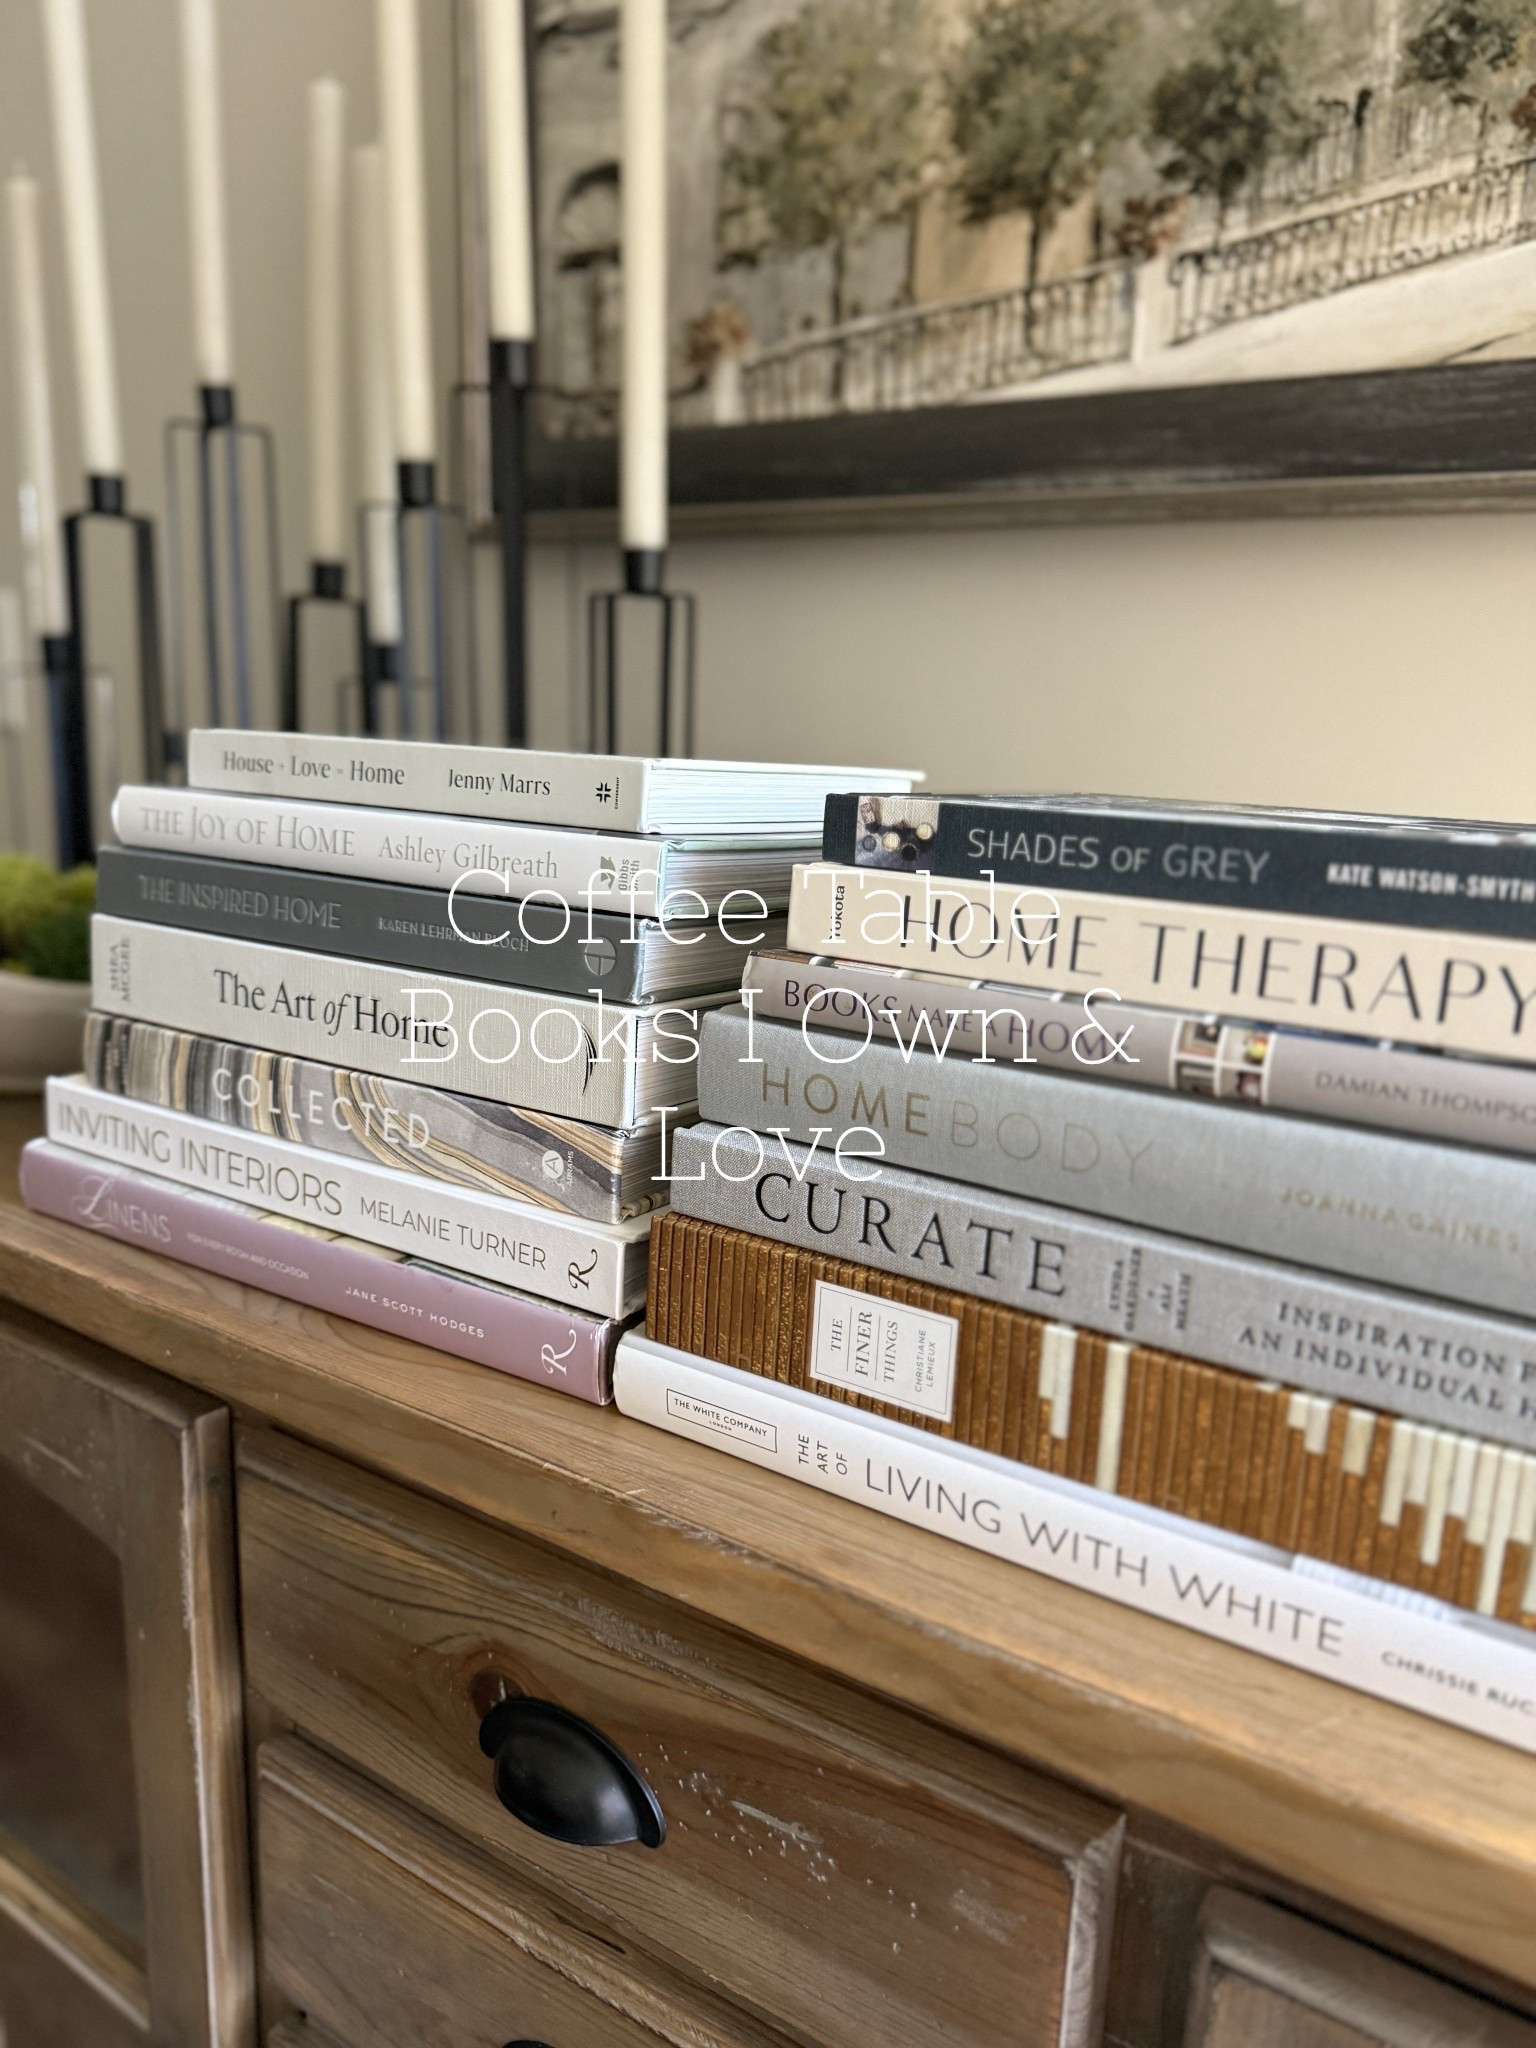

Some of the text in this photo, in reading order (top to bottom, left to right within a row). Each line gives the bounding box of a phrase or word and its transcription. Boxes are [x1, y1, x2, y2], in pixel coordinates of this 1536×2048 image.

[223, 750, 274, 774] House
[291, 755, 331, 778] Love
[350, 760, 405, 785] Home
[448, 769, 551, 796] Jenny Marrs
[140, 806, 355, 857] THE JOY OF HOME
[378, 834, 558, 879] Ashley Gilbreath
[968, 828, 1271, 885] SHADES OF GREY
[138, 874, 342, 929] THE INSPIRED HOME
[618, 859, 629, 891] Gibbs
[1326, 863, 1373, 888] KATE
[378, 917, 418, 934] KAREN
[900, 895, 1536, 1036] HOME THERAPY
[214, 969, 450, 1048] The Art of Home
[784, 980, 898, 1025] BOOKS
[907, 1003, 974, 1034] MAKE
[1008, 1015, 1133, 1064] HOME
[212, 1068, 430, 1149] COLLECTED
[1315, 1072, 1410, 1102] DAMIAN
[58, 1102, 343, 1216] INVITING INTERIORS
[360, 1197, 547, 1271] MELANIE TURNER
[755, 1172, 1067, 1297] CURATE
[1281, 1187, 1519, 1253] JOANNA GAINES
[344, 1286, 485, 1339] JANE SCOTT HODGES
[831, 1318, 843, 1352] THE
[1277, 1301, 1506, 1375] INSPIRATION
[854, 1310, 873, 1378] FINER
[883, 1320, 899, 1383] THINGS
[914, 1328, 927, 1393] CHRISTIANE
[925, 1340, 936, 1388] LEMIEUX
[1238, 1325, 1282, 1353] AN
[1293, 1338, 1504, 1411] INDIVIDUAL
[674, 1398, 768, 1437] THE WHITE COMPANY
[709, 1420, 732, 1432] LONDON
[798, 1433, 810, 1465] THE
[816, 1440, 829, 1475] ART
[836, 1452, 848, 1476] OF
[866, 1457, 1344, 1658] LIVING WITH WHITE
[1380, 1650, 1480, 1697] CHRISSIE
